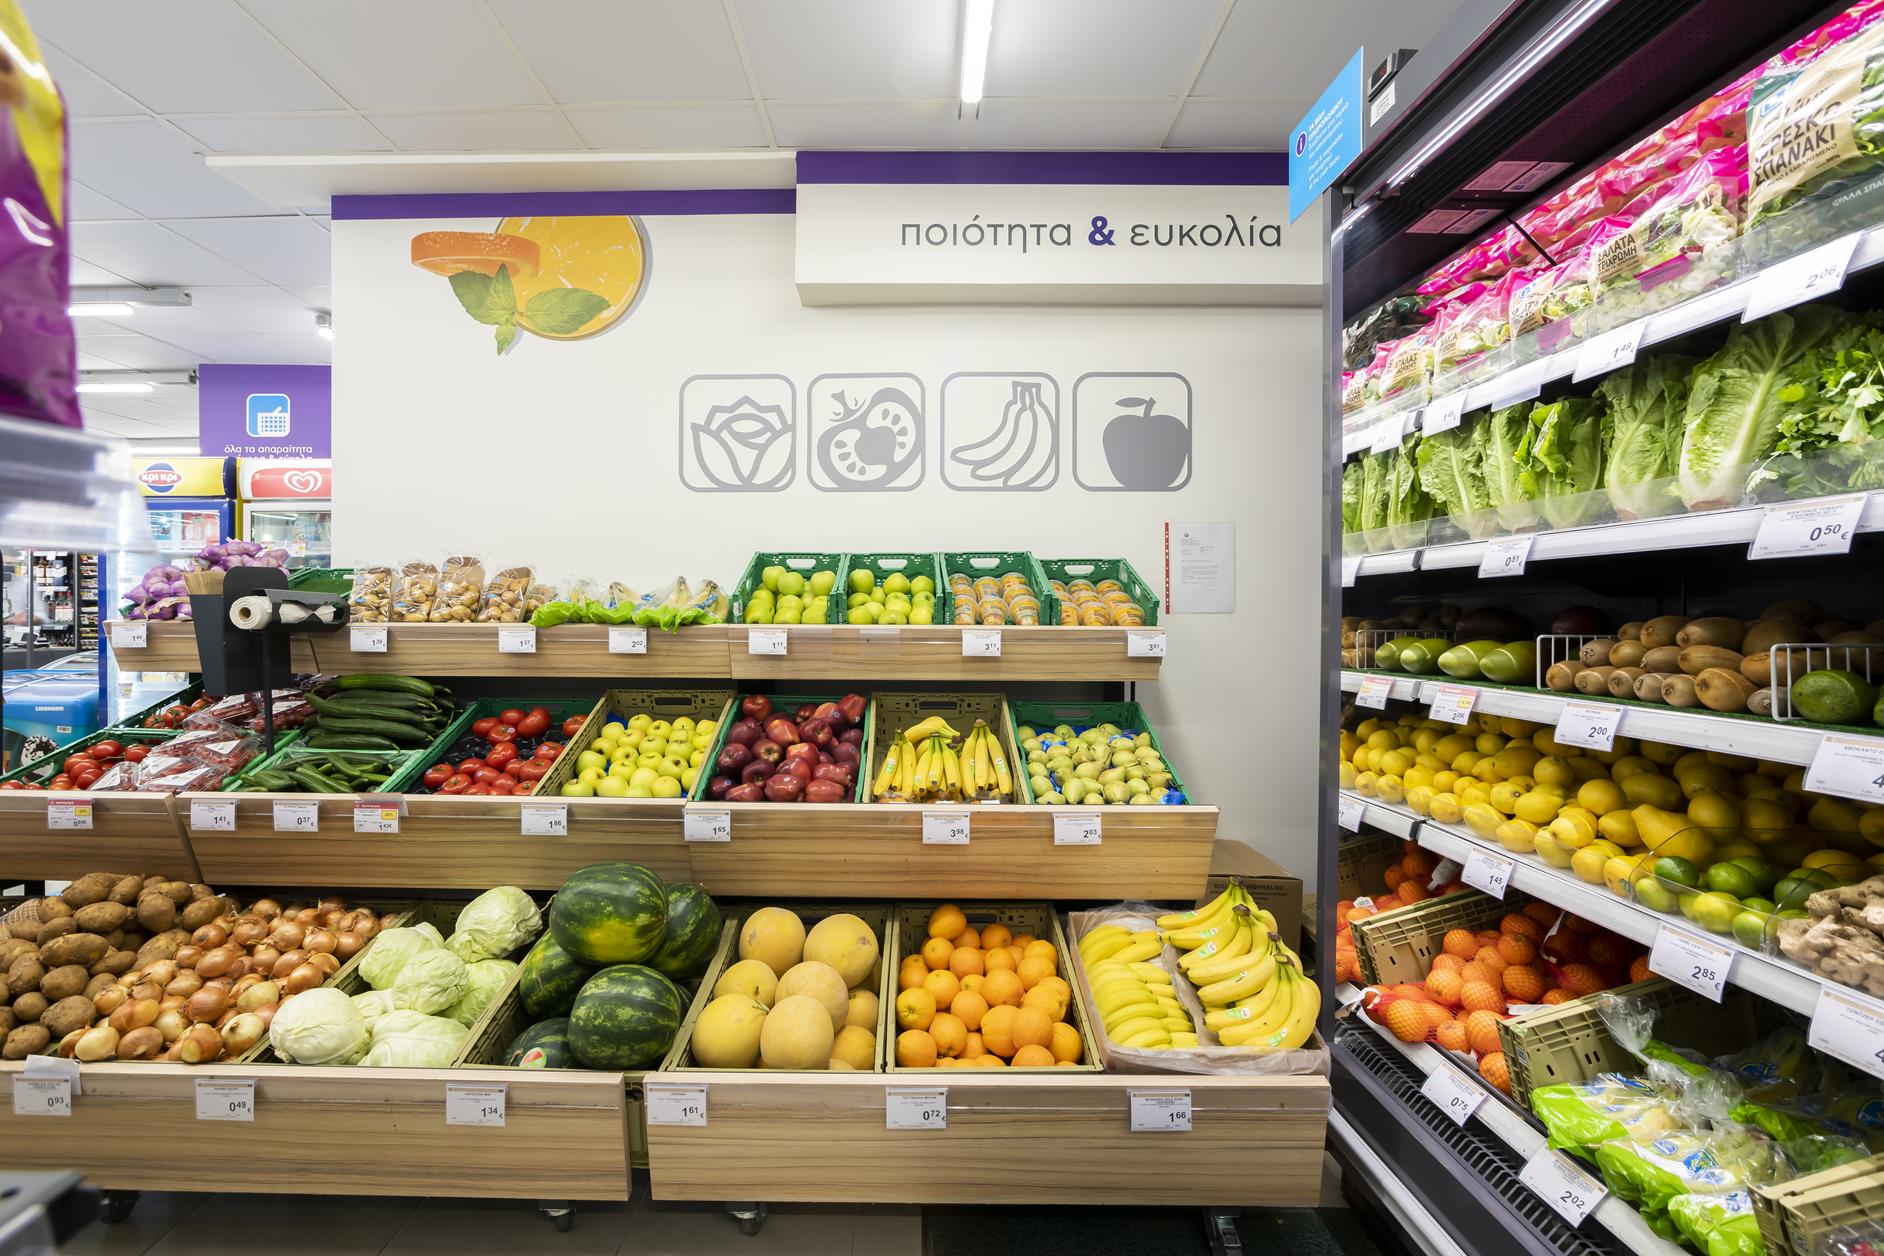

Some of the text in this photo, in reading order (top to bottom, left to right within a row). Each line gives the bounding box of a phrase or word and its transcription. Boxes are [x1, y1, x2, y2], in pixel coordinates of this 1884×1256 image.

[901, 214, 1282, 254] ποιότητα & ευκολία
[224, 444, 242, 453] όλα
[258, 444, 313, 455] απαραίτητα
